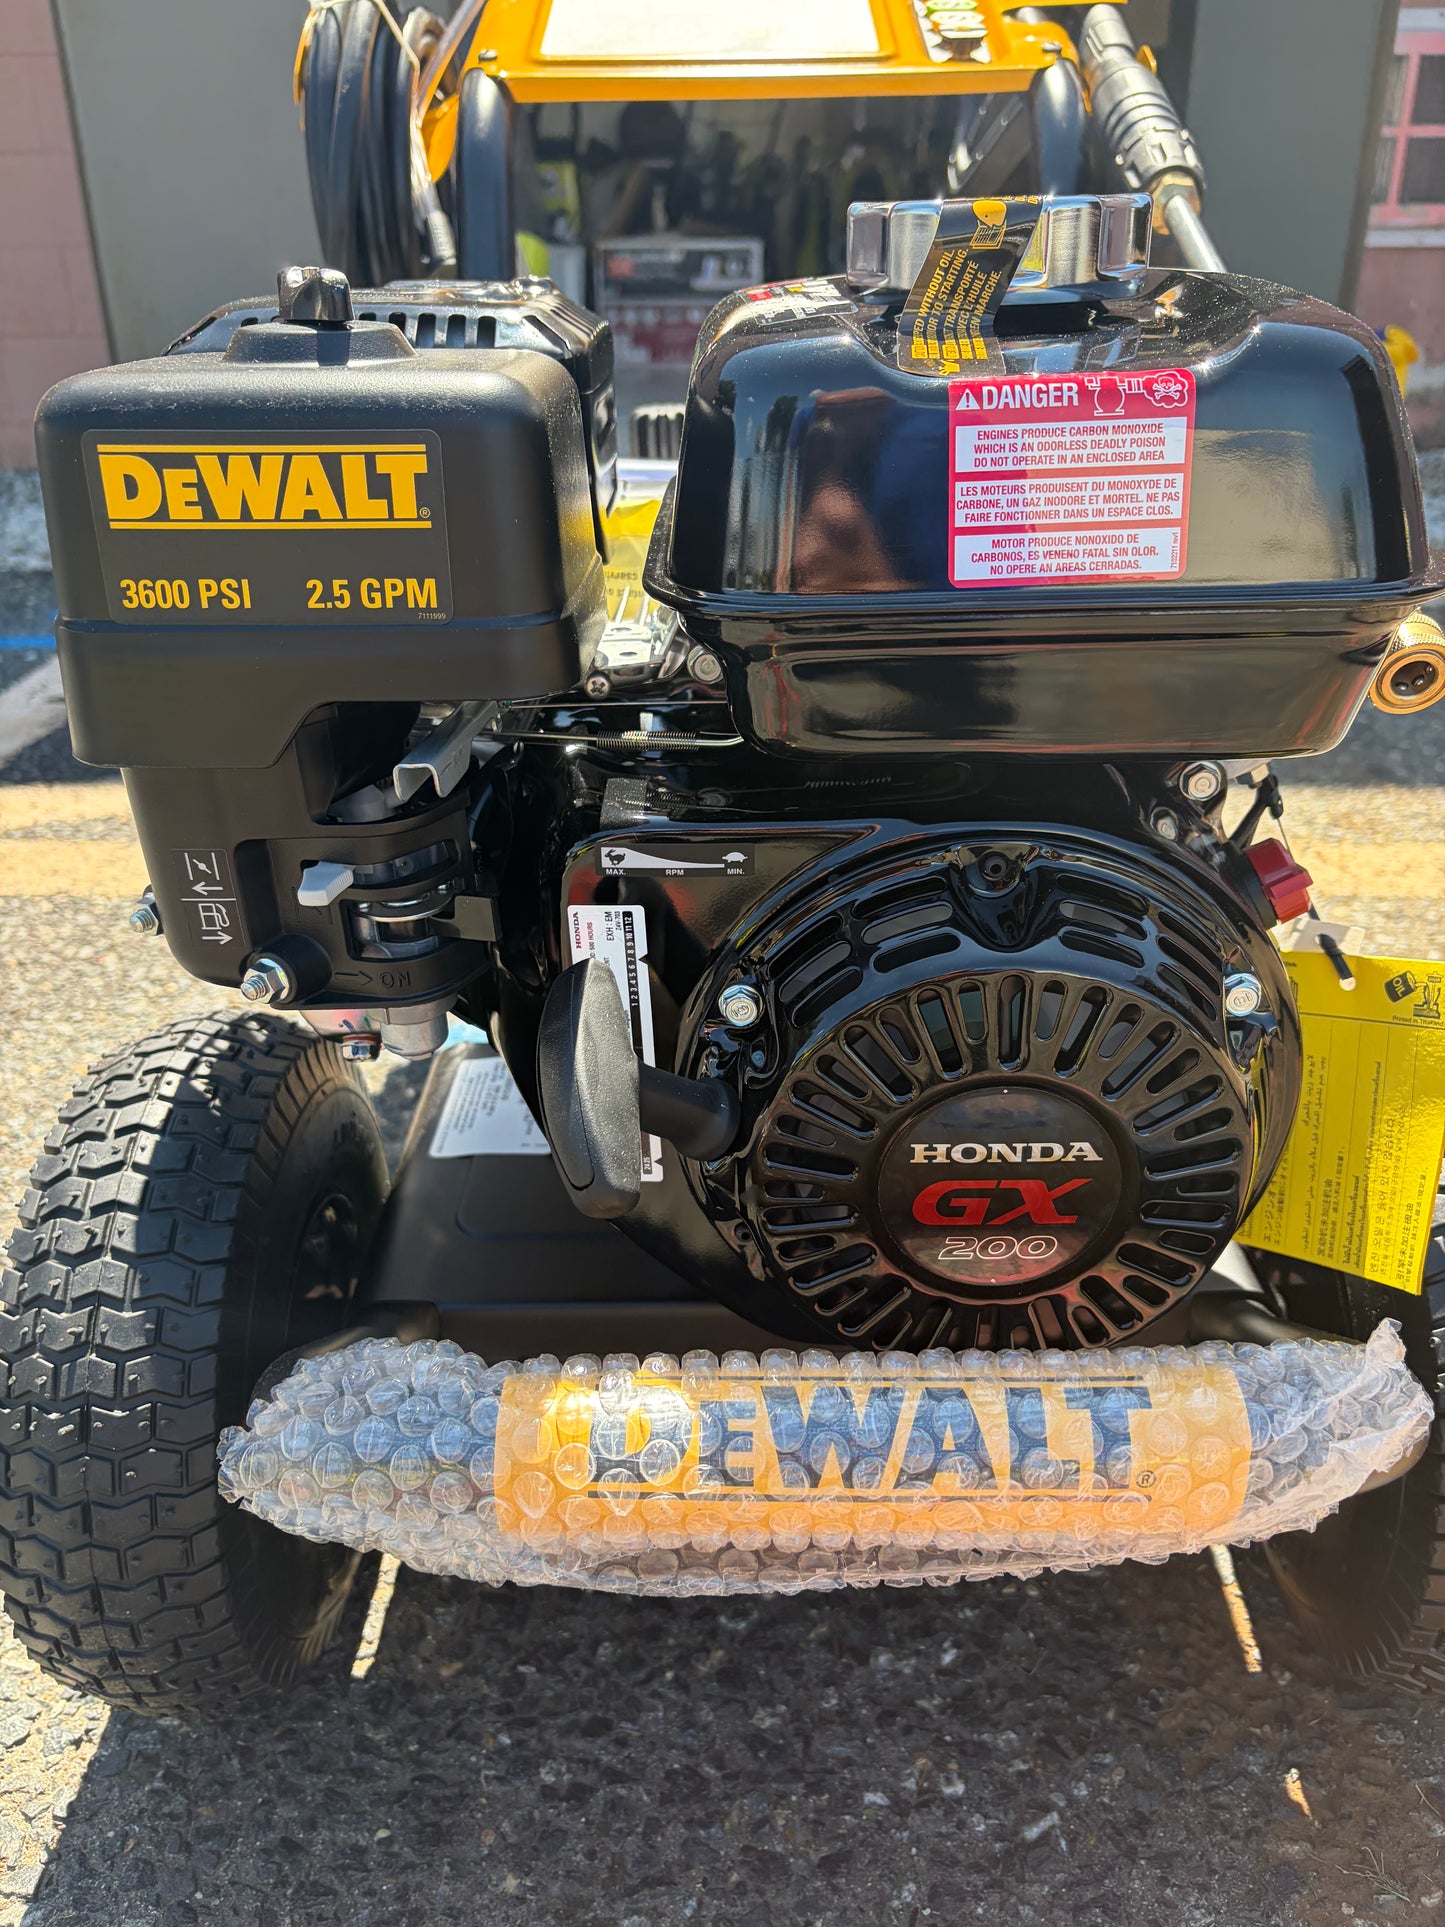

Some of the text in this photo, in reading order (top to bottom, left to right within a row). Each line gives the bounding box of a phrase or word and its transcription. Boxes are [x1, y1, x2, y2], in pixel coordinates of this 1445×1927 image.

[937, 248, 969, 302] STARTING.
[917, 267, 945, 317] WITHOUT
[944, 260, 979, 329] TRANSPORTÉ
[967, 272, 988, 311] L'HUILE
[974, 270, 1002, 317] MARCHE.
[932, 302, 944, 317] TO
[982, 382, 1079, 410] DANGER
[977, 423, 1164, 441] ENGINES PRODUCE CARBON MONOXIDE
[973, 436, 1166, 455] WHICH IS AN ODORLESS DEADLY POISON
[974, 450, 1165, 468] DO NOT OPERATE IN AN ENCLOSED AREA
[960, 478, 1177, 498] LES MOTEURS PRODUISENT DU MONOXYDE DE
[956, 491, 1180, 510] CARBONE, UN GAZ INODORE ET MORTEL. NE PAS
[964, 504, 1174, 523] FAIRE FONCTIONNER DANS UN ESPACE CLOS.
[991, 533, 1139, 549] MOTOR PRODUCE NONOXIDO DE
[970, 546, 1160, 564] CARBONOS, ES VENENO FATAL SIN OLOR.
[990, 559, 1142, 575] NO OPERE AN AREAS CERRADAS.
[120, 578, 252, 609] 3600 PSI
[306, 578, 438, 609] 2.5 GPM
[604, 911, 613, 922] EM
[572, 912, 582, 949] HONDA
[605, 927, 615, 941] EXH
[379, 971, 411, 989] ON
[1392, 977, 1406, 998] OIL
[1392, 1015, 1412, 1024] Printed
[910, 1141, 1104, 1164] HONDA
[912, 1178, 1094, 1225] GX
[938, 1235, 1058, 1260] 200
